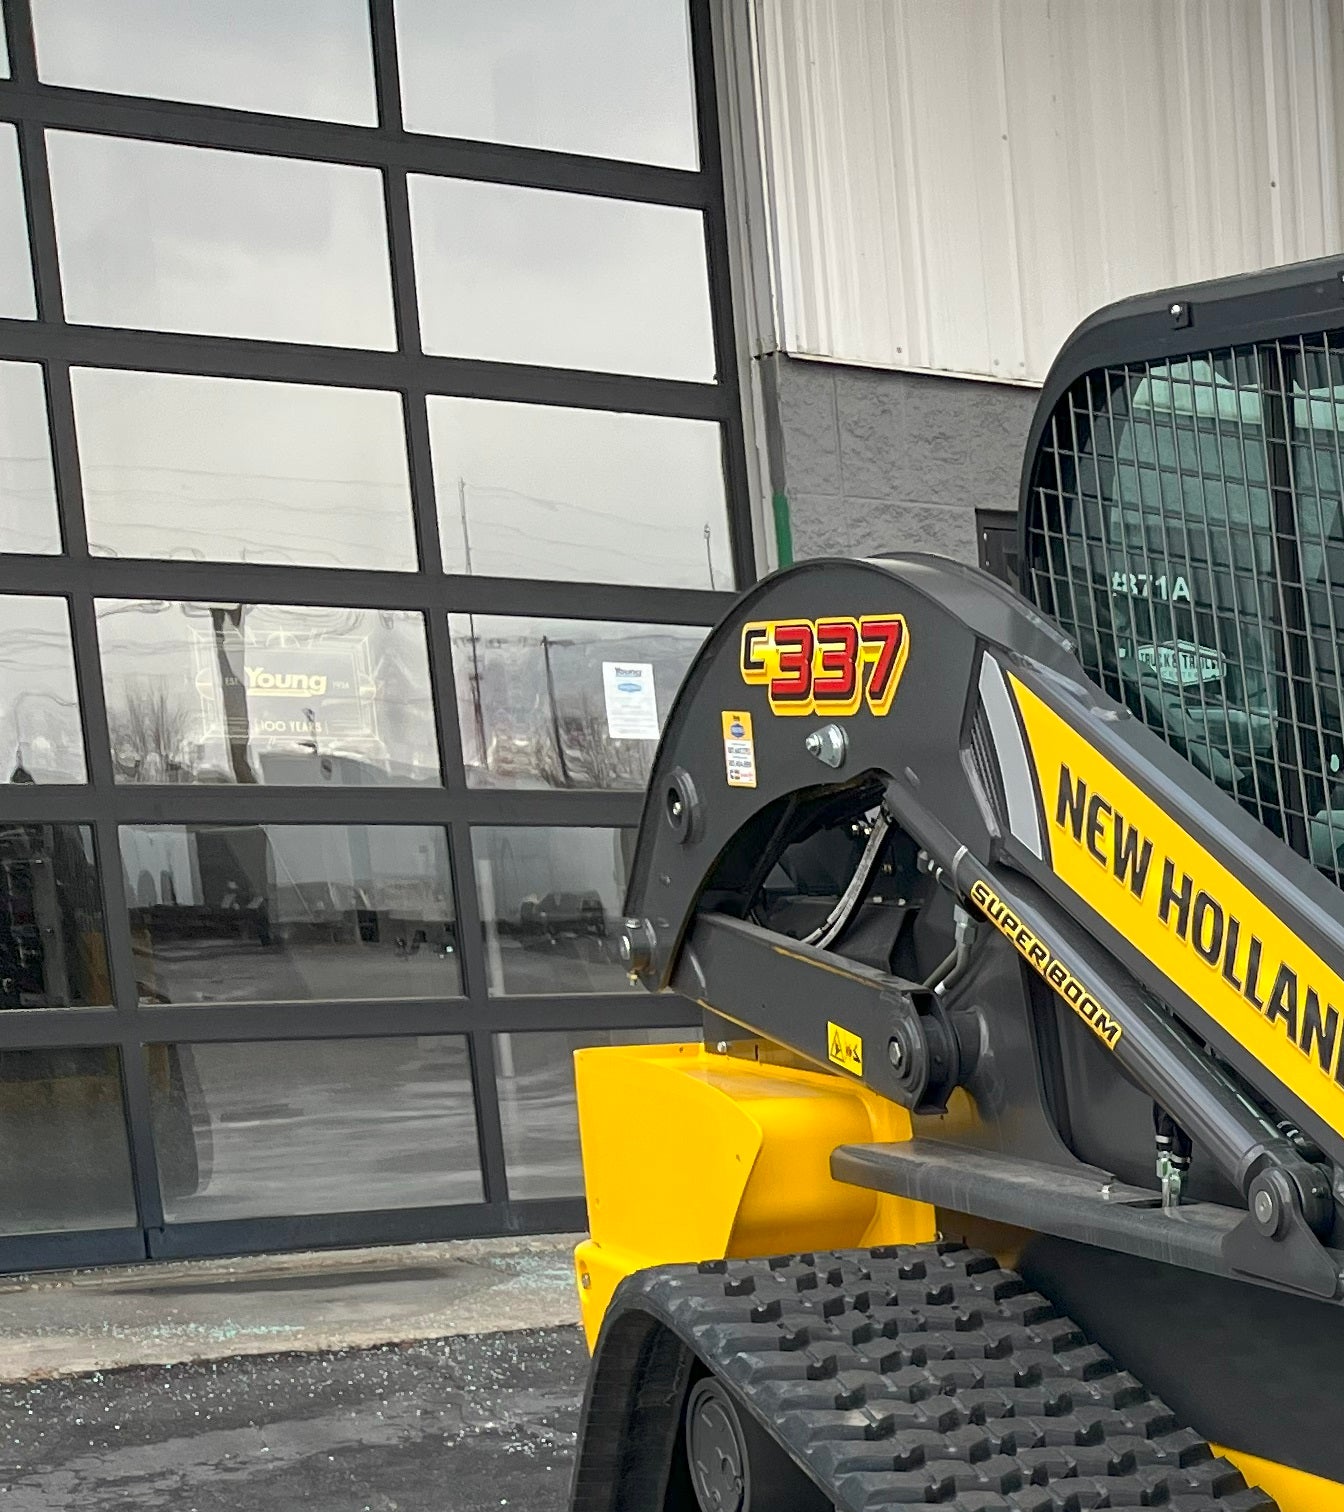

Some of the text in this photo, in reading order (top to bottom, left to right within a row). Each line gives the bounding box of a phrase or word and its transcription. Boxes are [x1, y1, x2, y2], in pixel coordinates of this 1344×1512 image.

[244, 666, 327, 696] Young
[742, 614, 908, 708] C337
[261, 721, 286, 732] 100
[1055, 761, 1153, 902] NEW
